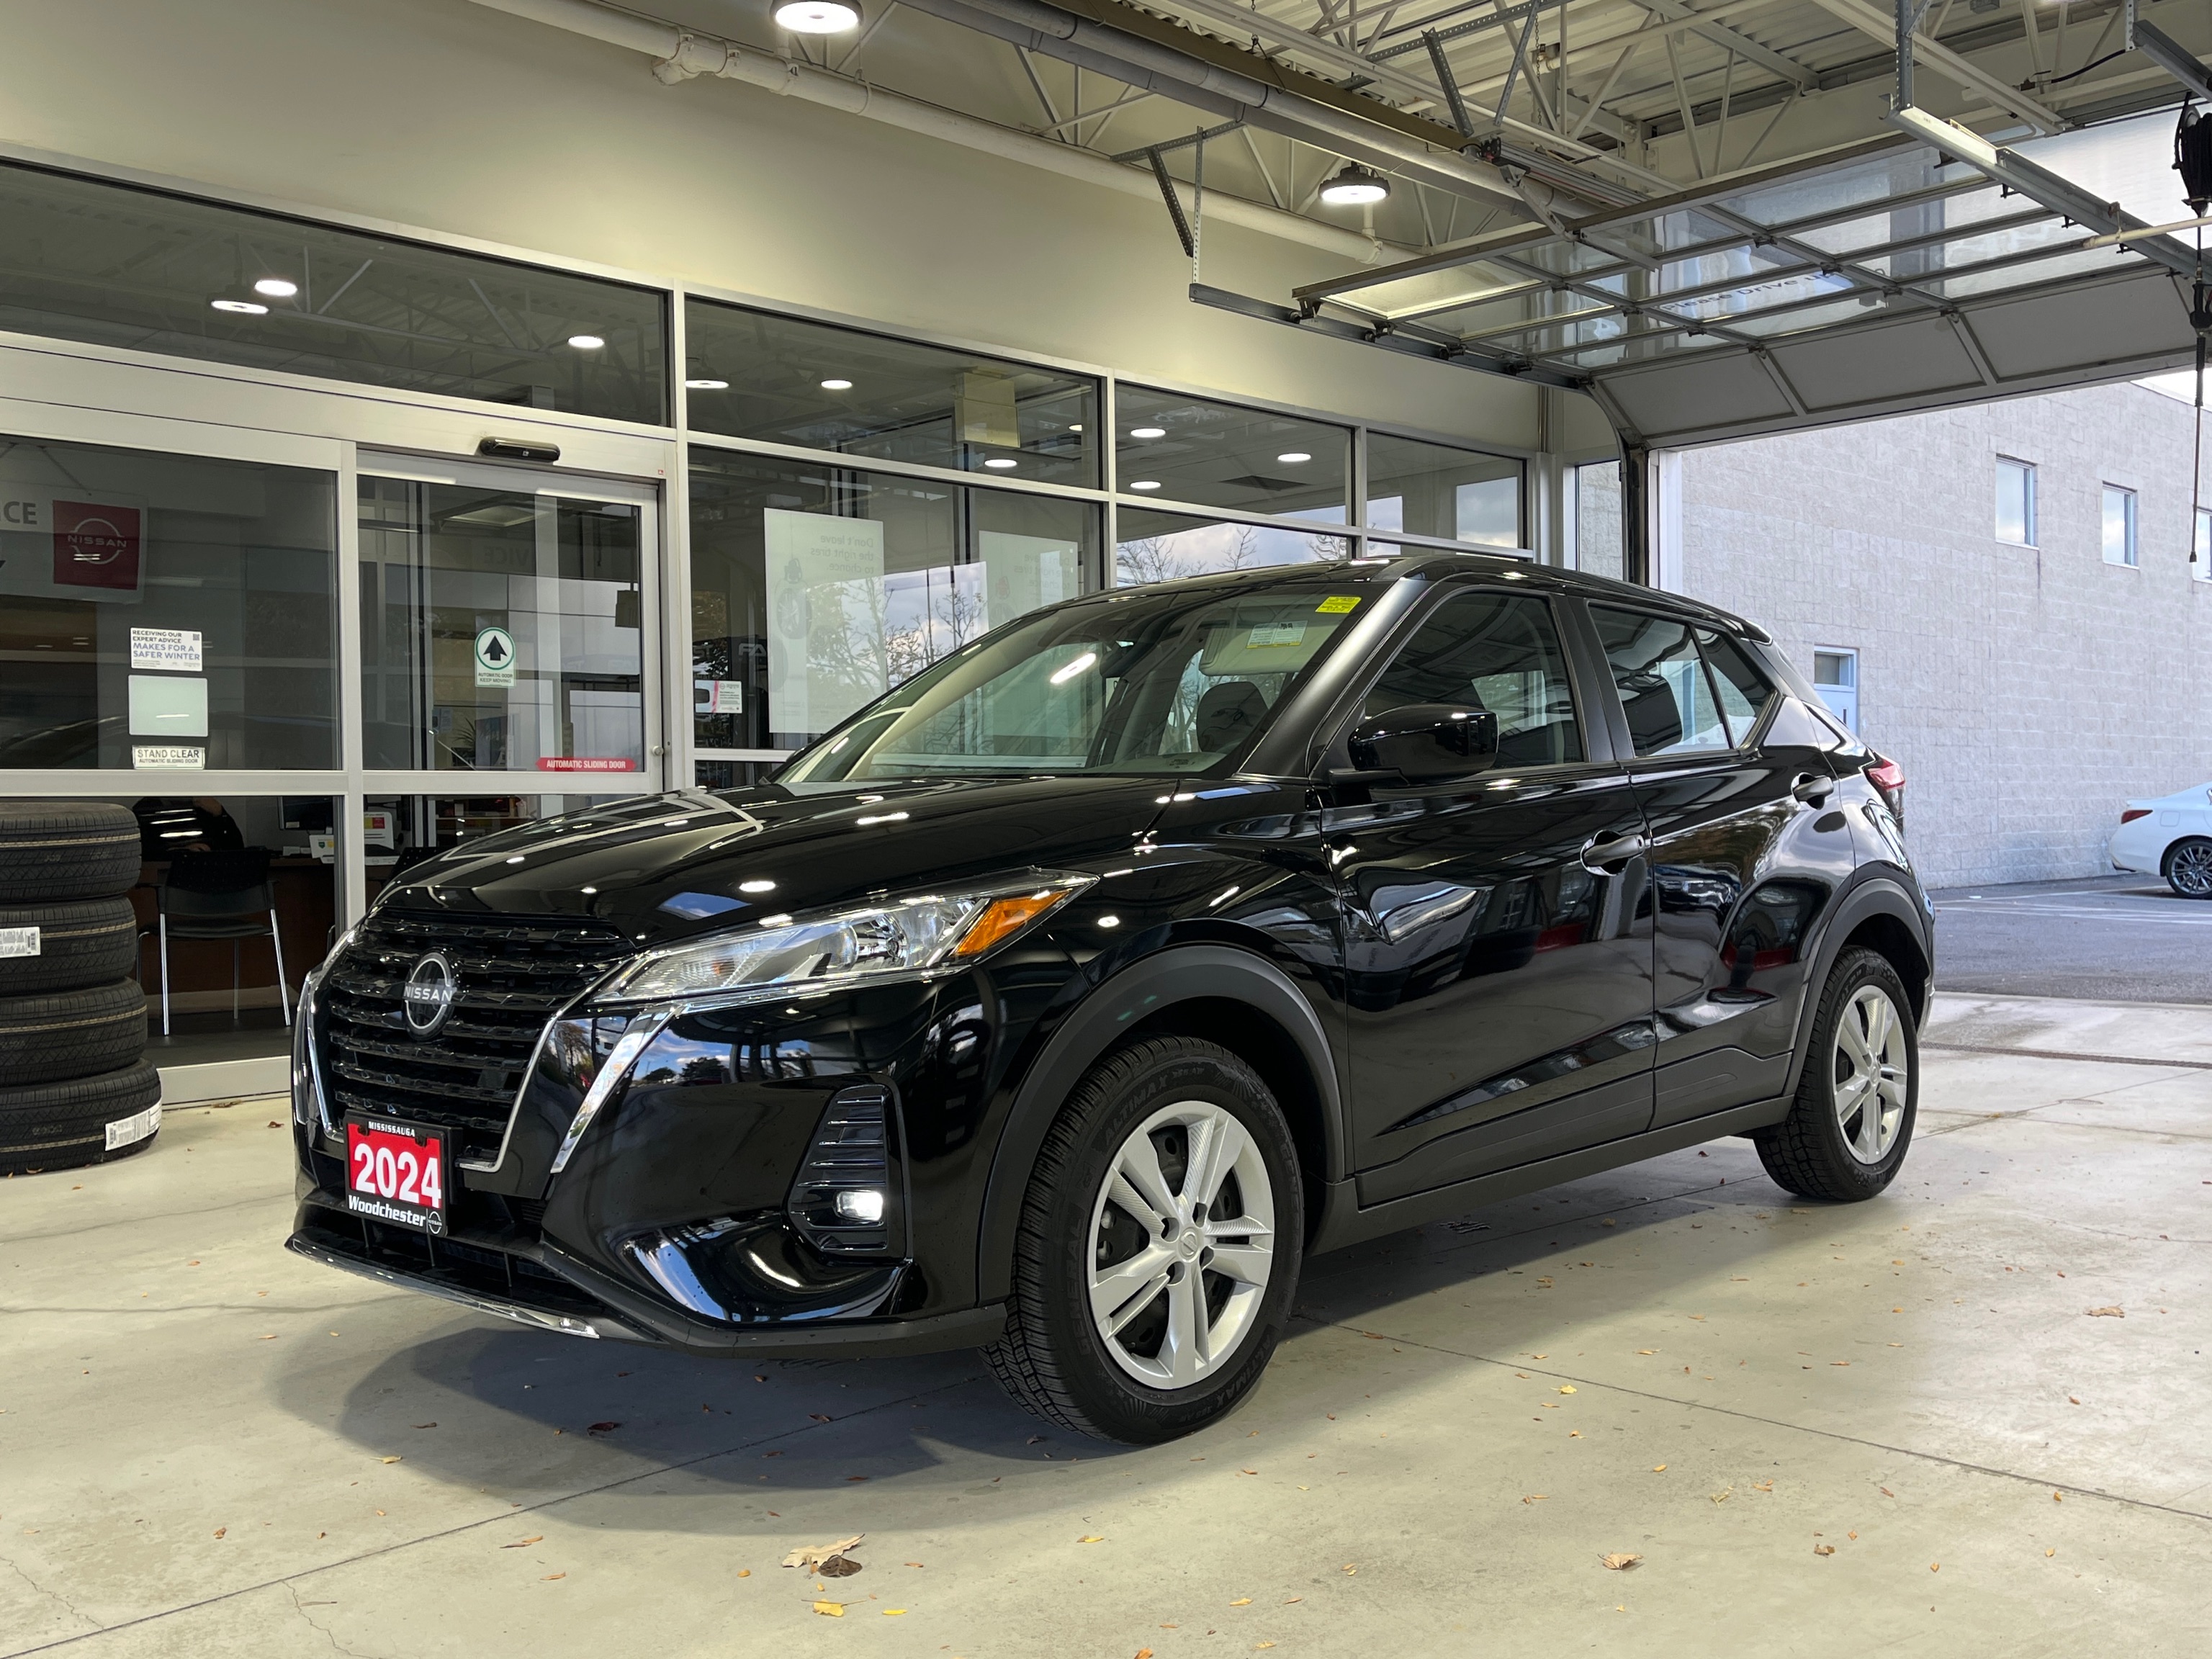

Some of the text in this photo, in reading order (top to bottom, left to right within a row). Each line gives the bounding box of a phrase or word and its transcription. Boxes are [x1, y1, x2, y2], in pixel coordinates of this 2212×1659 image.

[1664, 293, 1732, 312] Please
[1736, 278, 1799, 296] Drive
[0, 501, 37, 525] CE
[68, 534, 127, 548] NISSAN
[133, 642, 166, 651] MAKES
[133, 650, 200, 660] SAFER WINTER
[138, 749, 199, 758] STAND CLEAR
[547, 760, 626, 769] AUTOMATIC SLIDING DOOR
[403, 986, 454, 1002] NISSAN
[368, 1121, 415, 1137] MISSISSAUGA
[354, 1143, 442, 1209] 2024
[349, 1195, 426, 1227] Woodchester
